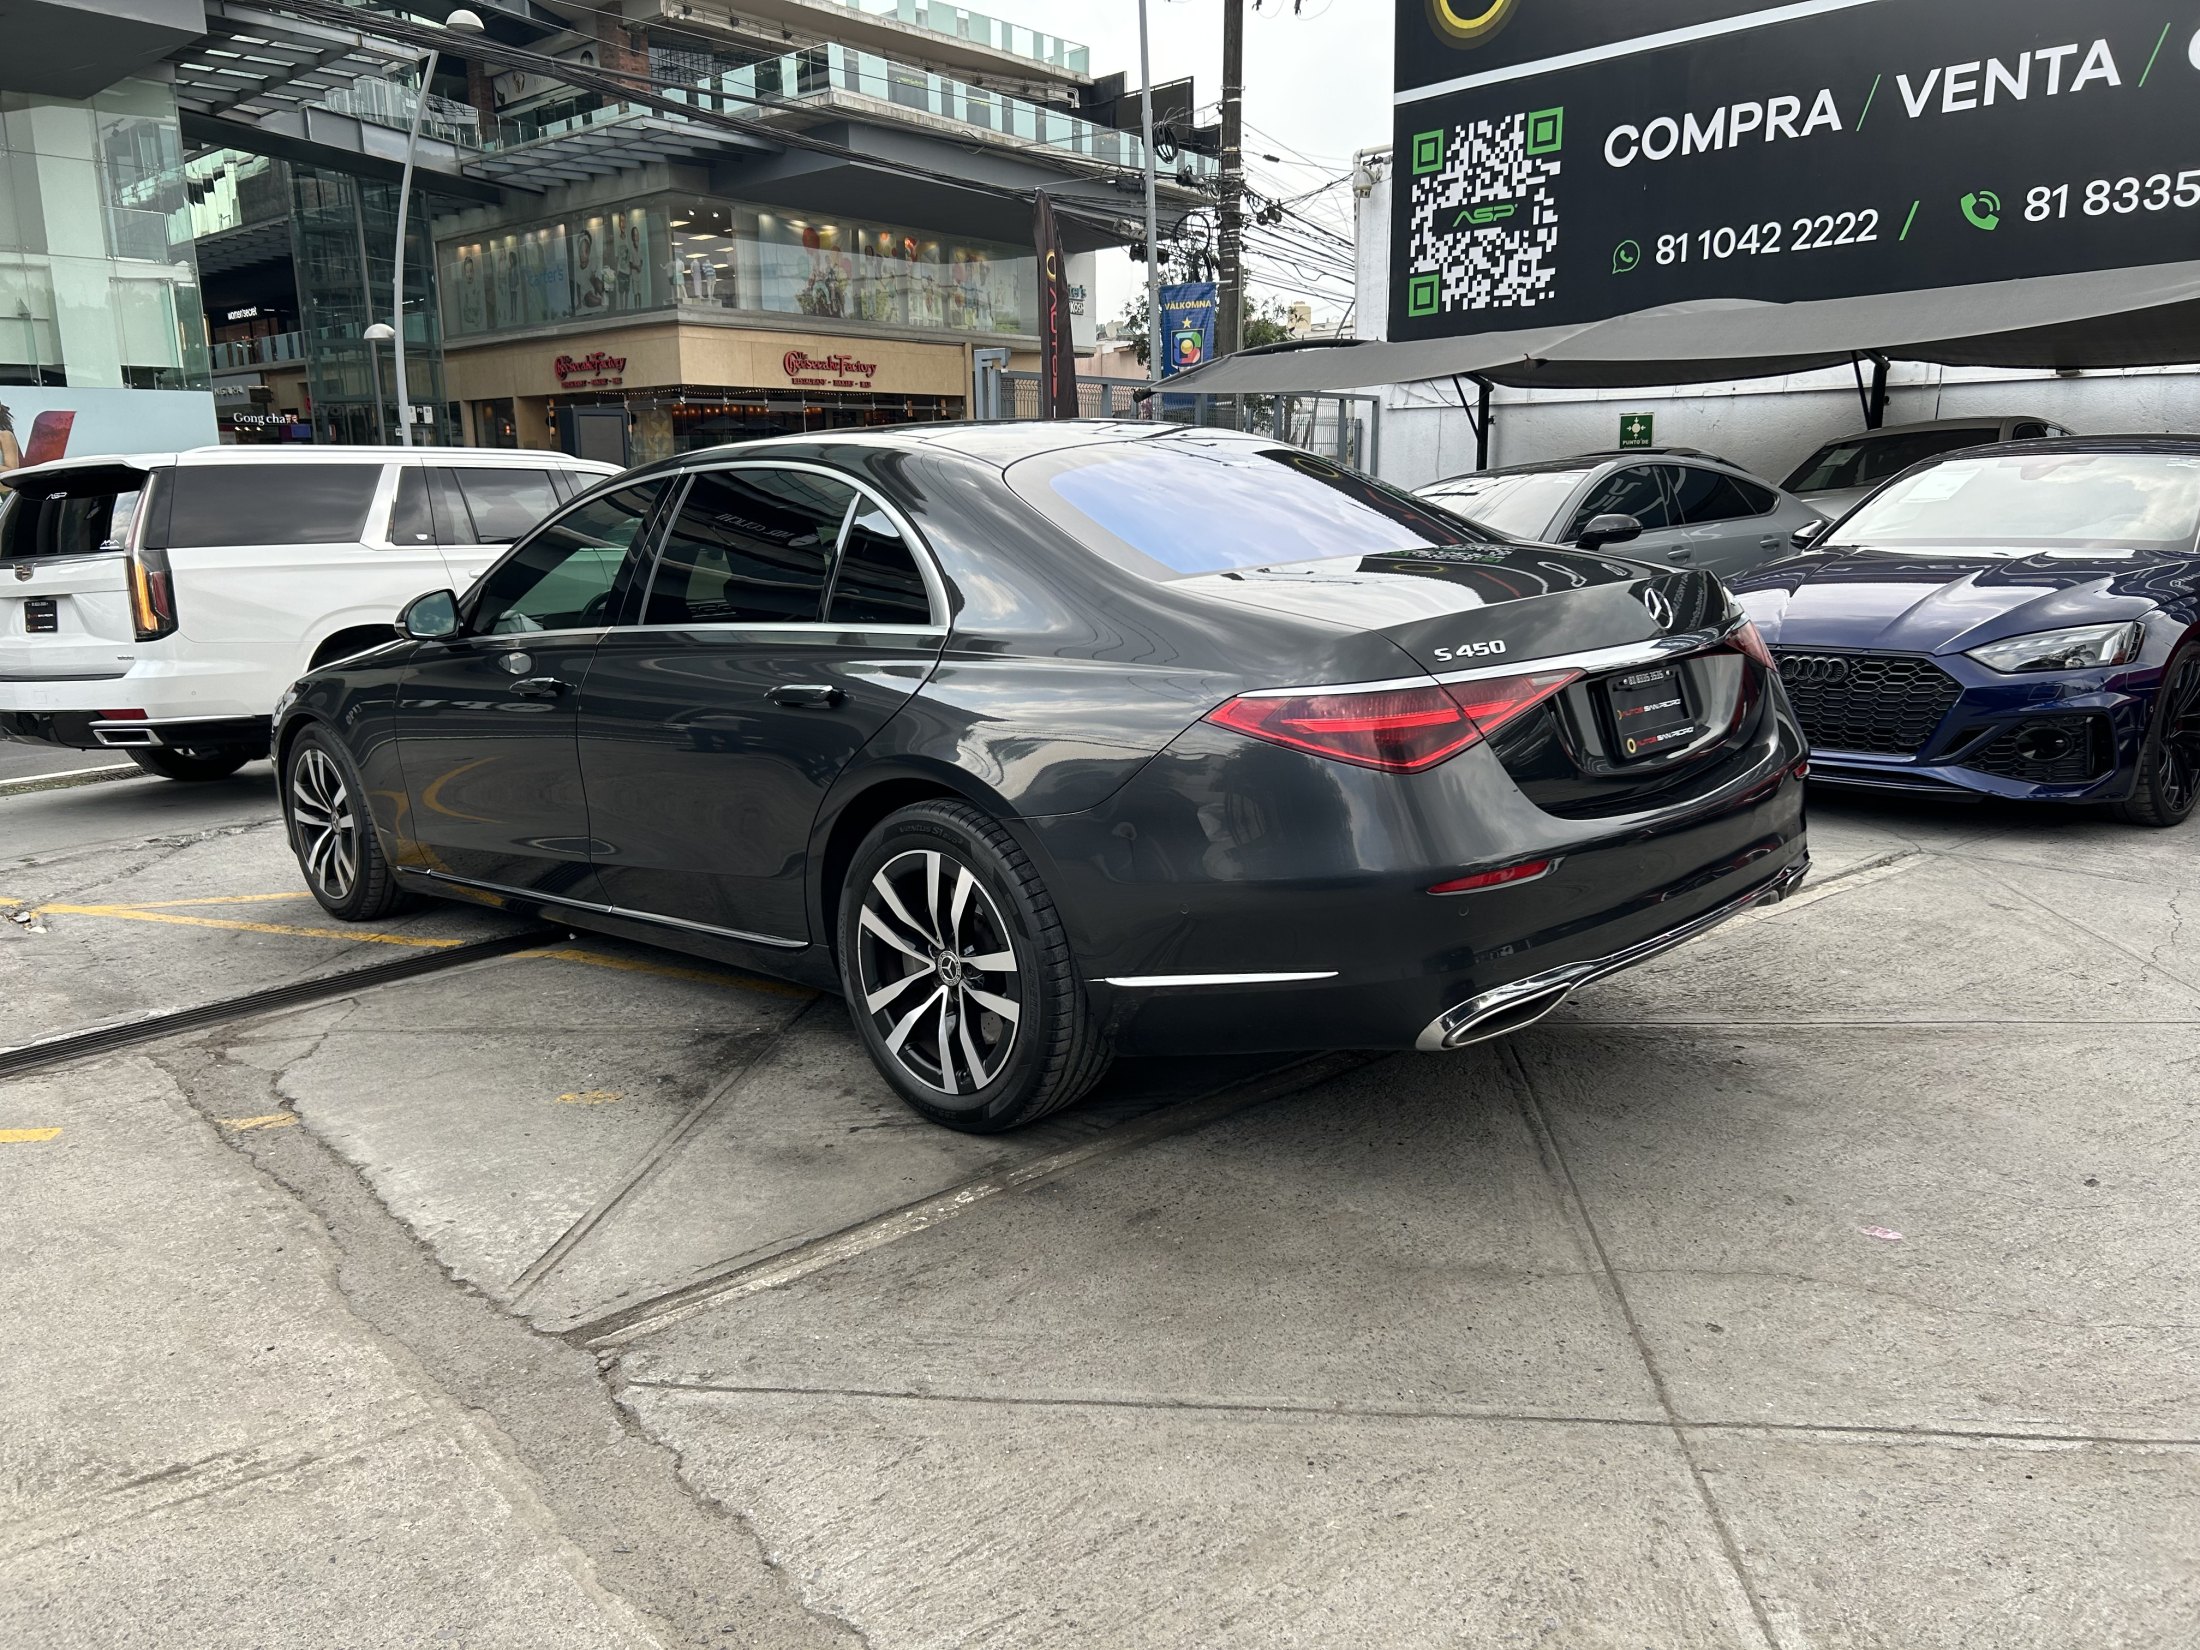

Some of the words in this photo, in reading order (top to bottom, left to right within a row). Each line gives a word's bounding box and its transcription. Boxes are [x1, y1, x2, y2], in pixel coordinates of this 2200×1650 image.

[1604, 88, 1842, 168] COMPRA
[1895, 39, 2122, 119] VENTA
[1453, 204, 1517, 227] ASP
[1655, 232, 1688, 265] 81
[1698, 221, 1782, 260] 1042
[1790, 208, 1879, 251] 2222
[2024, 184, 2069, 222] 81
[2082, 169, 2200, 216] 8335
[834, 354, 878, 378] Factory
[233, 412, 265, 426] Gong
[266, 413, 286, 424] cha
[1433, 647, 1453, 662] S
[1455, 639, 1508, 657] 450
